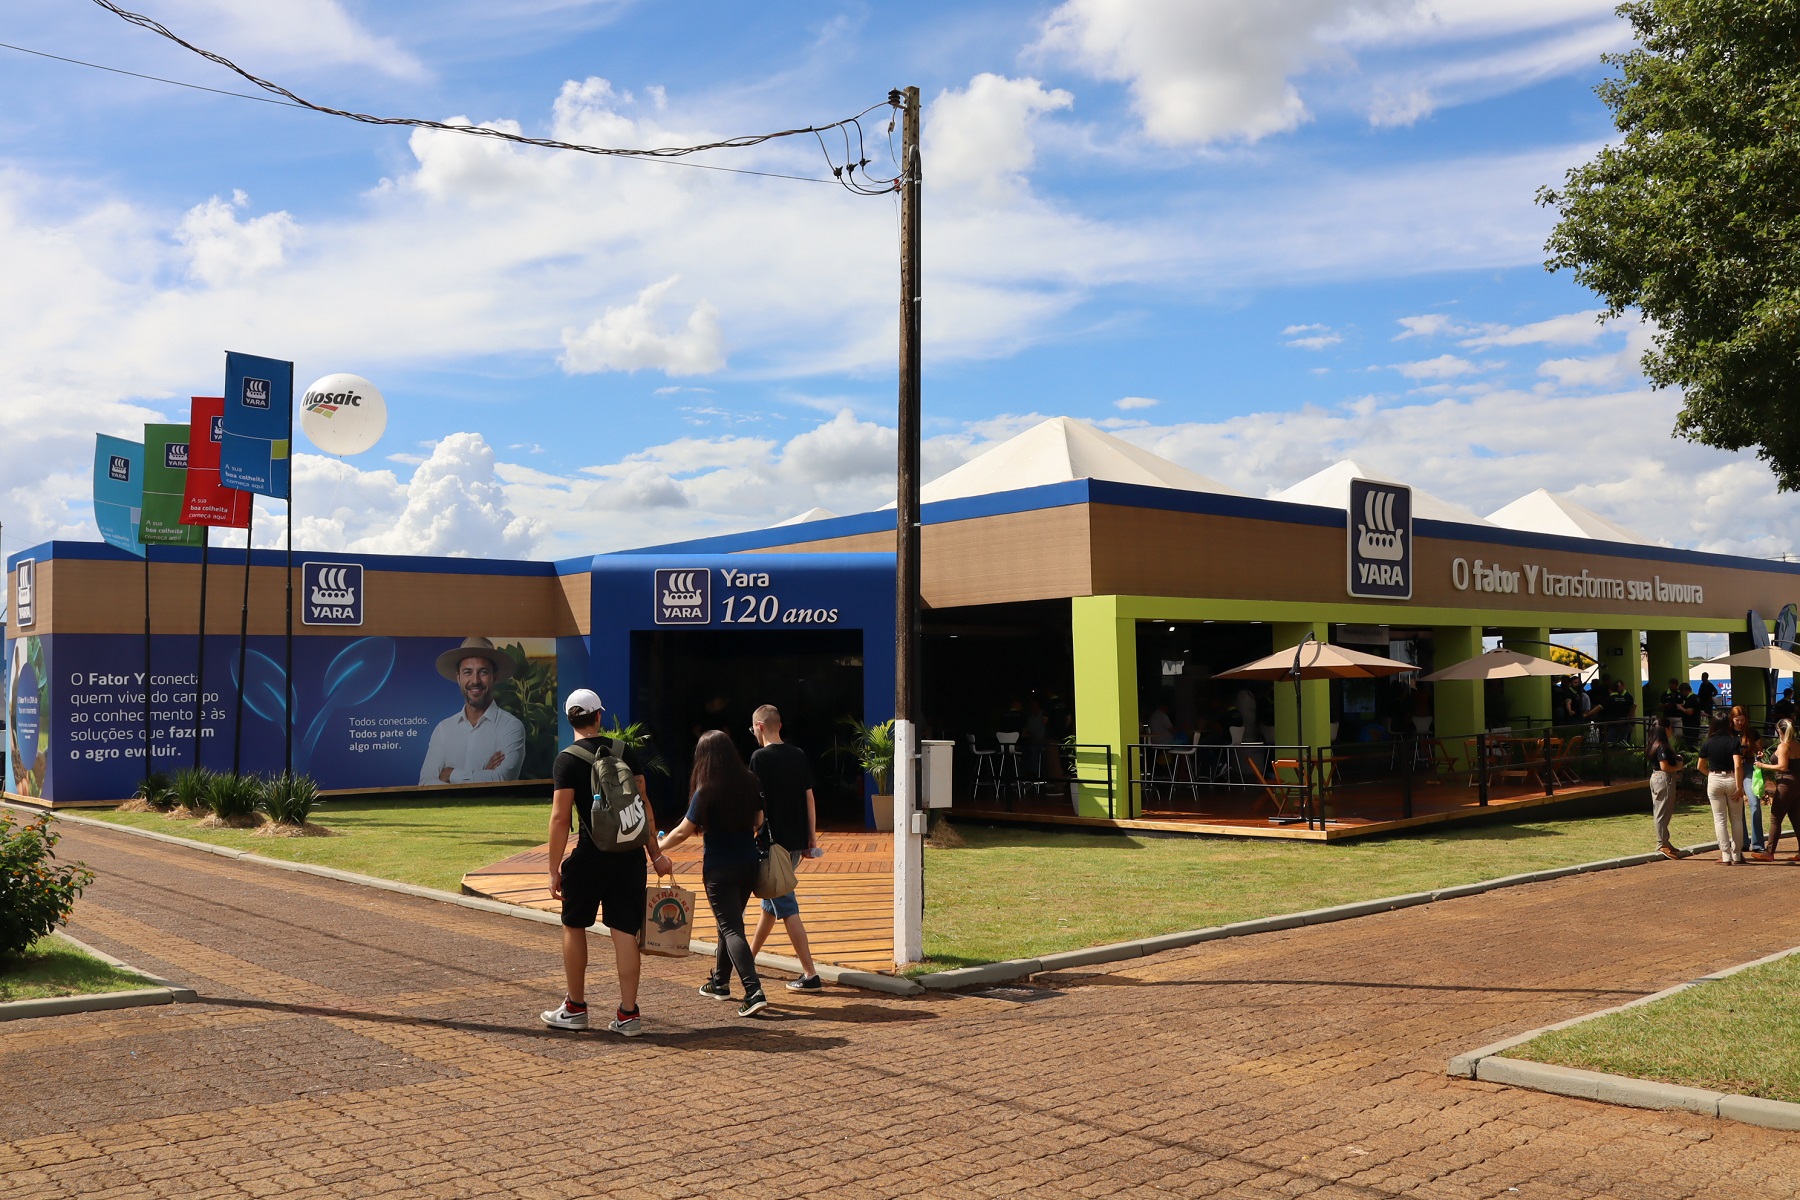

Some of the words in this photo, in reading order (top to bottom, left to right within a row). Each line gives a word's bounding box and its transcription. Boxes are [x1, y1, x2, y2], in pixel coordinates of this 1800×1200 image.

[246, 398, 266, 406] YARA
[303, 390, 362, 406] Mosaic
[720, 569, 770, 587] Yara
[1358, 562, 1404, 586] YARA
[1452, 558, 1469, 590] O
[1472, 559, 1520, 594] fator
[1522, 564, 1539, 594] Y
[1542, 567, 1624, 600] transforma
[1627, 580, 1652, 601] sua
[1654, 575, 1703, 604] lavoura
[311, 606, 354, 618] YARA
[662, 607, 702, 618] YARA
[720, 595, 779, 623] 120
[782, 607, 838, 623] anos
[71, 673, 83, 686] O
[89, 672, 130, 685] Fator
[134, 673, 146, 685] Y
[70, 694, 113, 706] quem
[118, 691, 146, 704] vive
[151, 691, 168, 703] do
[173, 692, 219, 705] campo
[71, 712, 88, 722] ao
[94, 709, 193, 722] conhecmento
[210, 708, 226, 720] às
[349, 718, 376, 726] Todos
[378, 716, 430, 725] conectados.
[71, 727, 133, 743] soluções
[138, 729, 164, 742] que
[349, 730, 377, 738] Todos
[380, 729, 404, 739] parte
[406, 728, 418, 737] de
[70, 750, 80, 759] o
[85, 748, 119, 762] agro
[124, 744, 182, 758] evoluir.
[349, 742, 369, 753] algo
[372, 741, 401, 750] maior.
[619, 794, 644, 831] NIKE
